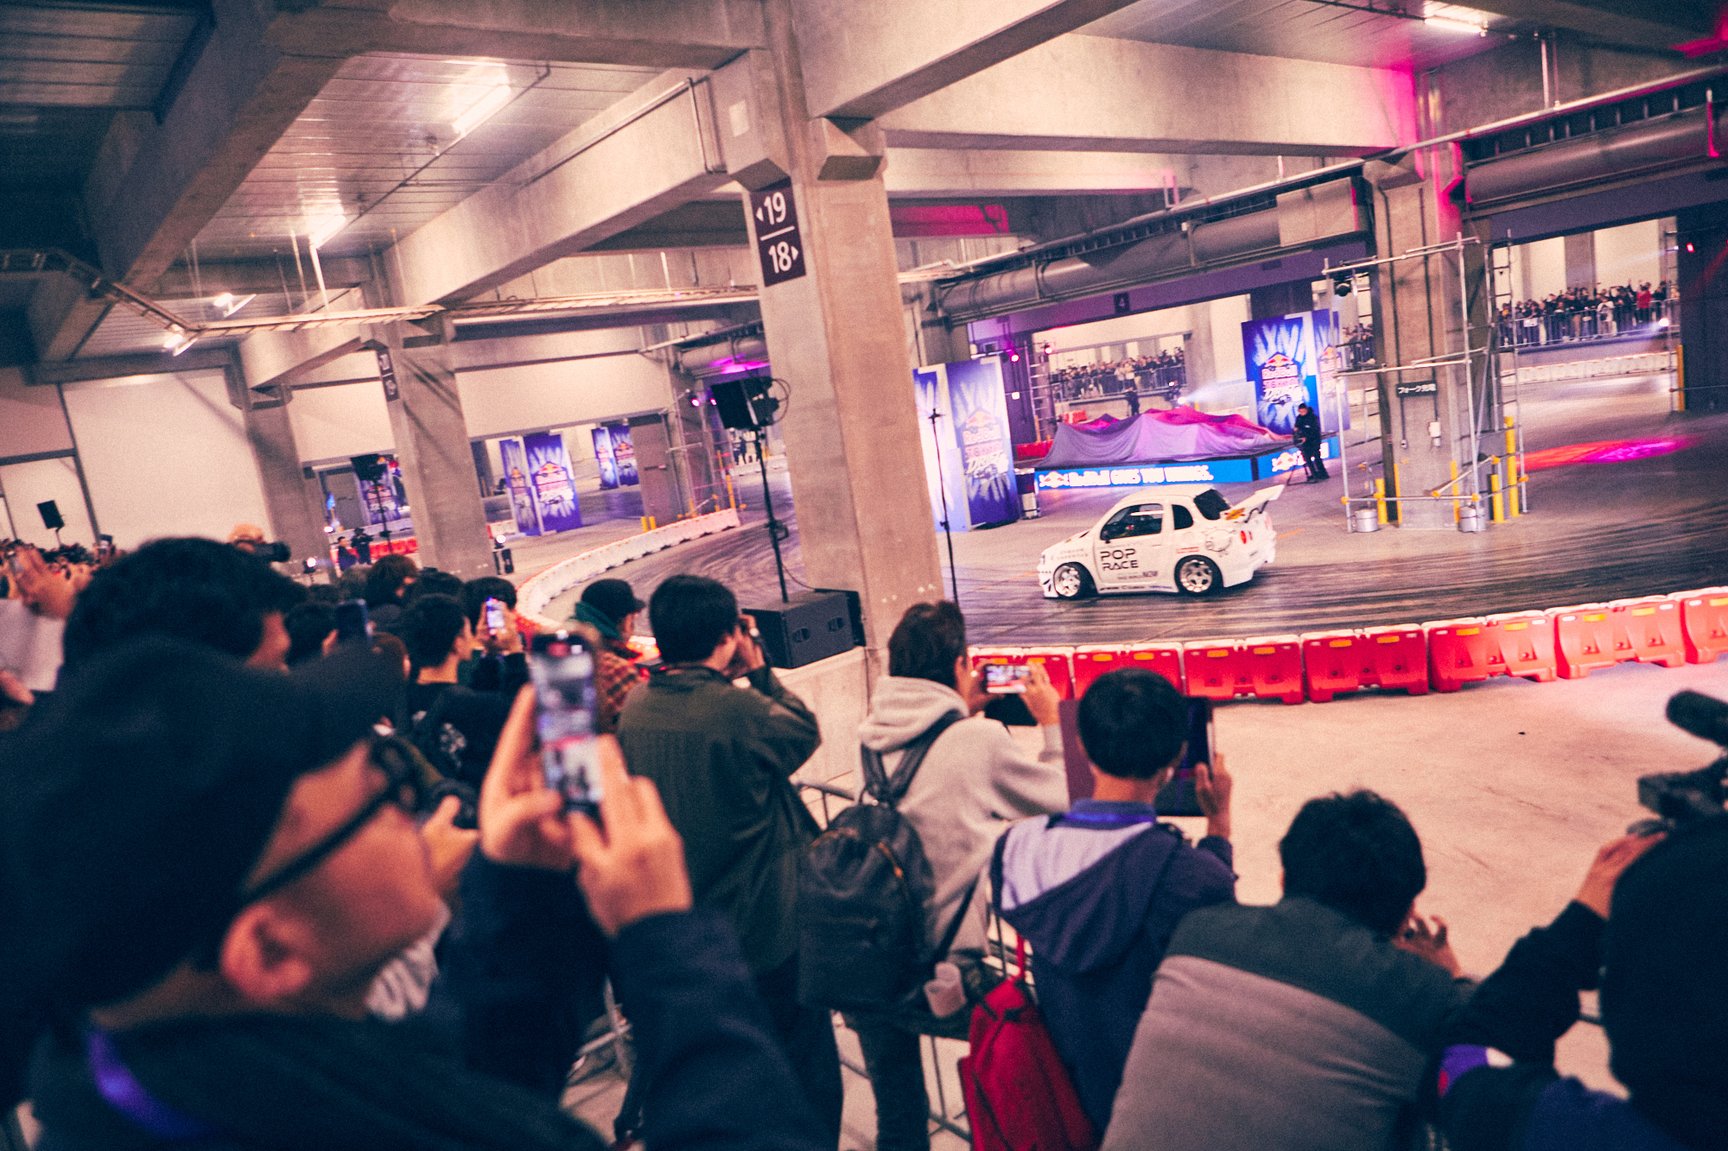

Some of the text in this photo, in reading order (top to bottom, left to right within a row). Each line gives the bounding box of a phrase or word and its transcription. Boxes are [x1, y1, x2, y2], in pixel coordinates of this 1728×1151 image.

[764, 191, 787, 225] 19
[768, 241, 792, 274] 18
[1100, 548, 1136, 561] POP
[1102, 560, 1139, 571] RACE
